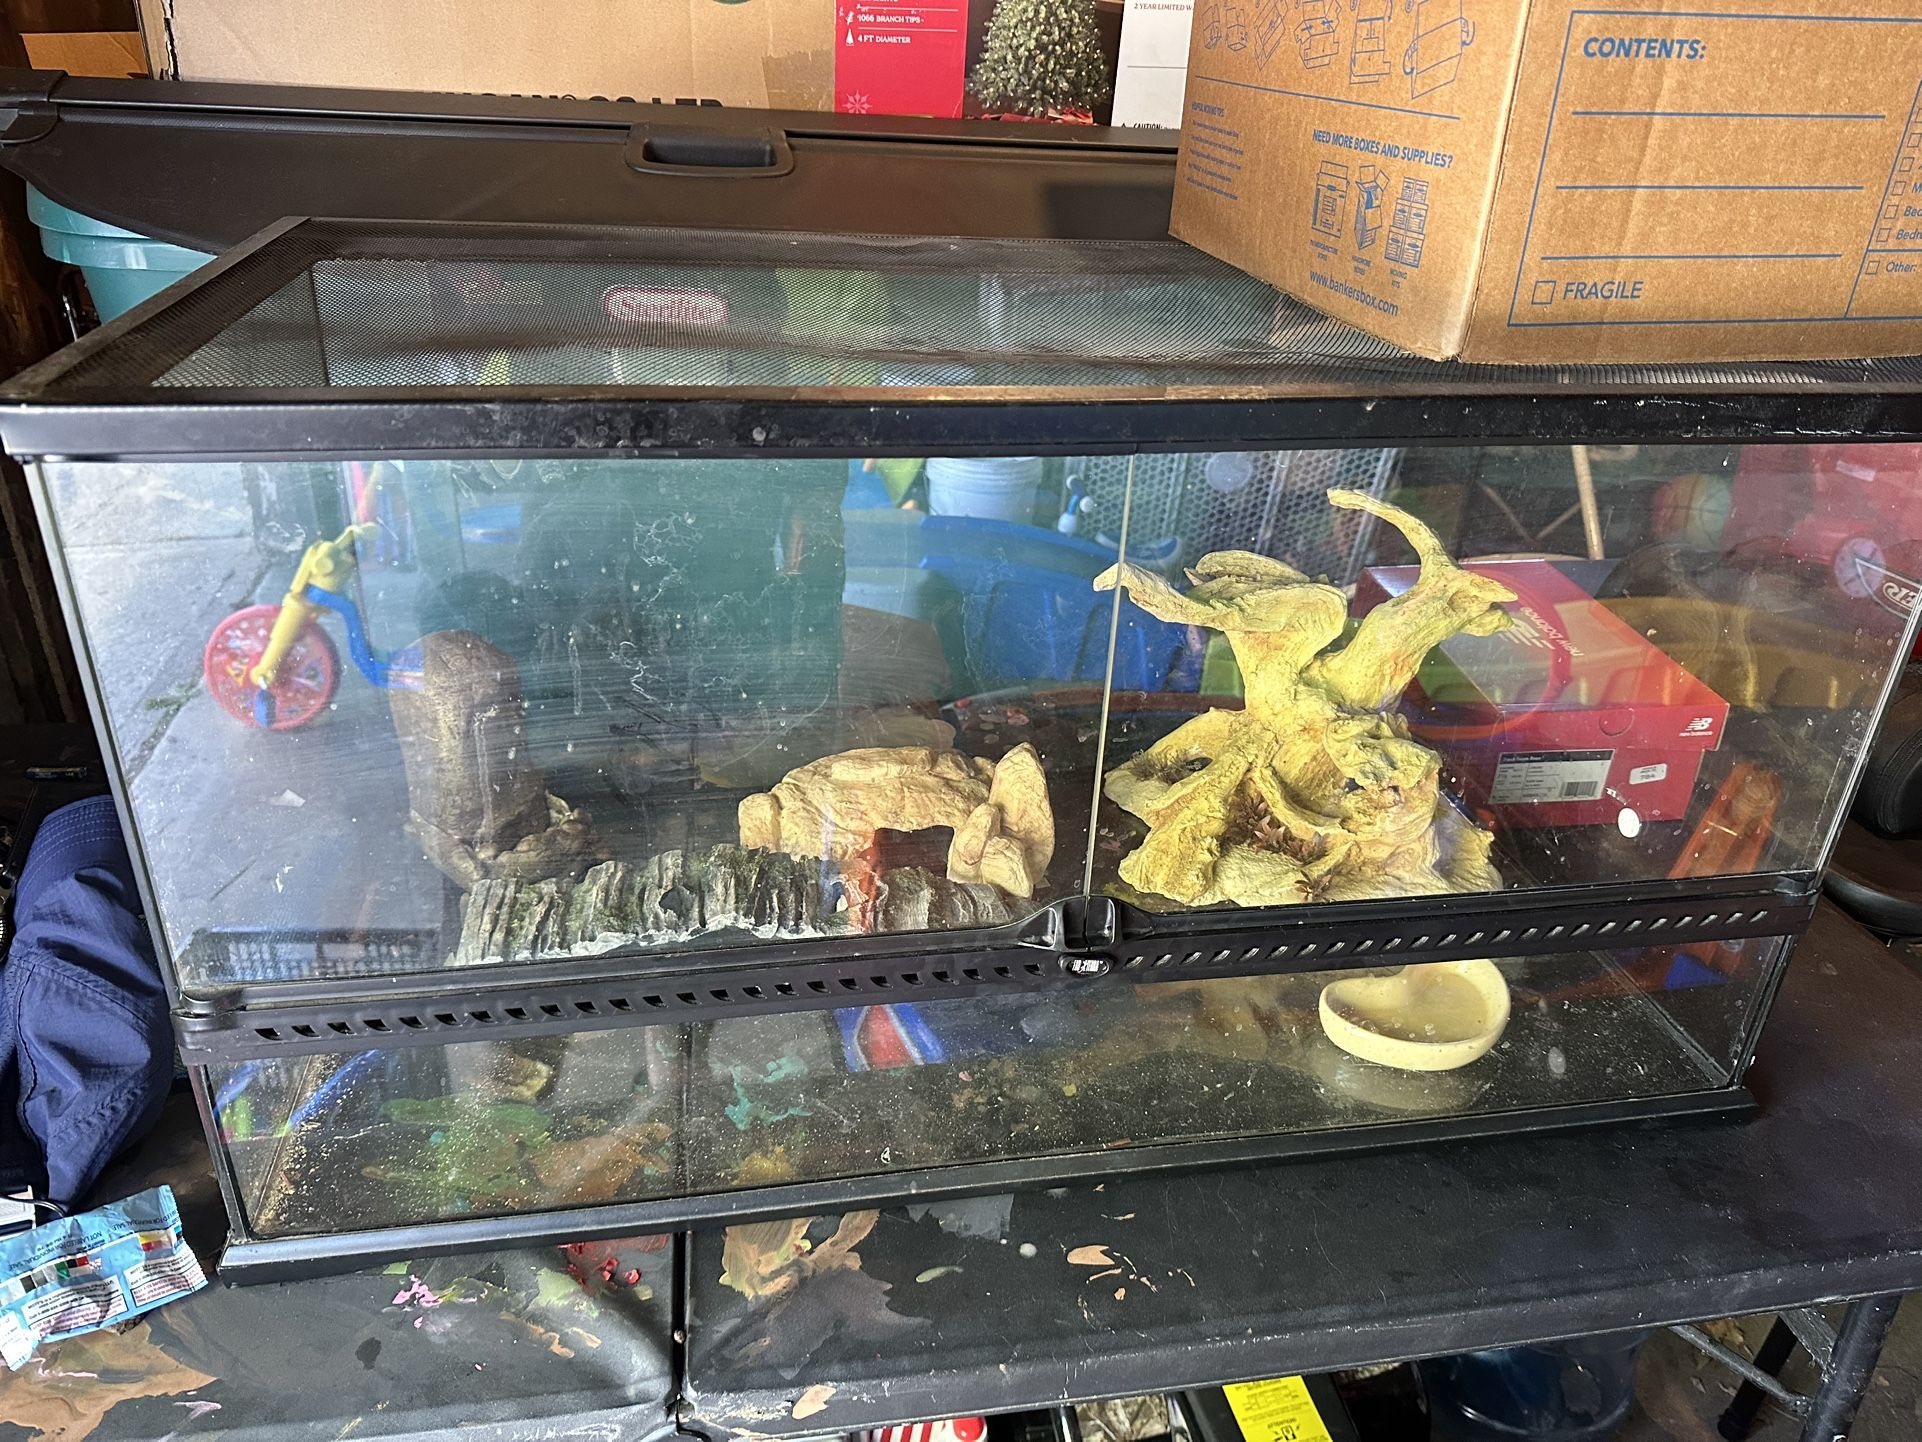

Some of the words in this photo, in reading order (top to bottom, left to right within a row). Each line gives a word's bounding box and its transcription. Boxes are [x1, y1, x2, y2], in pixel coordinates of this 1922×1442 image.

[1157, 3, 1185, 11] LIMITED
[857, 14, 875, 22] 1066
[876, 15, 904, 23] BRANCH
[905, 16, 921, 24] TIPS
[857, 35, 863, 43] 4
[863, 35, 875, 43] FT
[875, 35, 911, 43] DIAMETER
[1583, 36, 1707, 60] CONTENTS:
[1312, 129, 1331, 144] NEED
[1331, 133, 1353, 149] MORE
[1354, 137, 1380, 155] BOXES
[1380, 143, 1400, 159] AND
[1401, 146, 1454, 168] SUPPLIES?
[1885, 261, 1917, 273] Other:
[1310, 270, 1399, 317] www.bankersbox.com
[1563, 280, 1644, 300] FRAGILE
[90, 1231, 103, 1241] NOT
